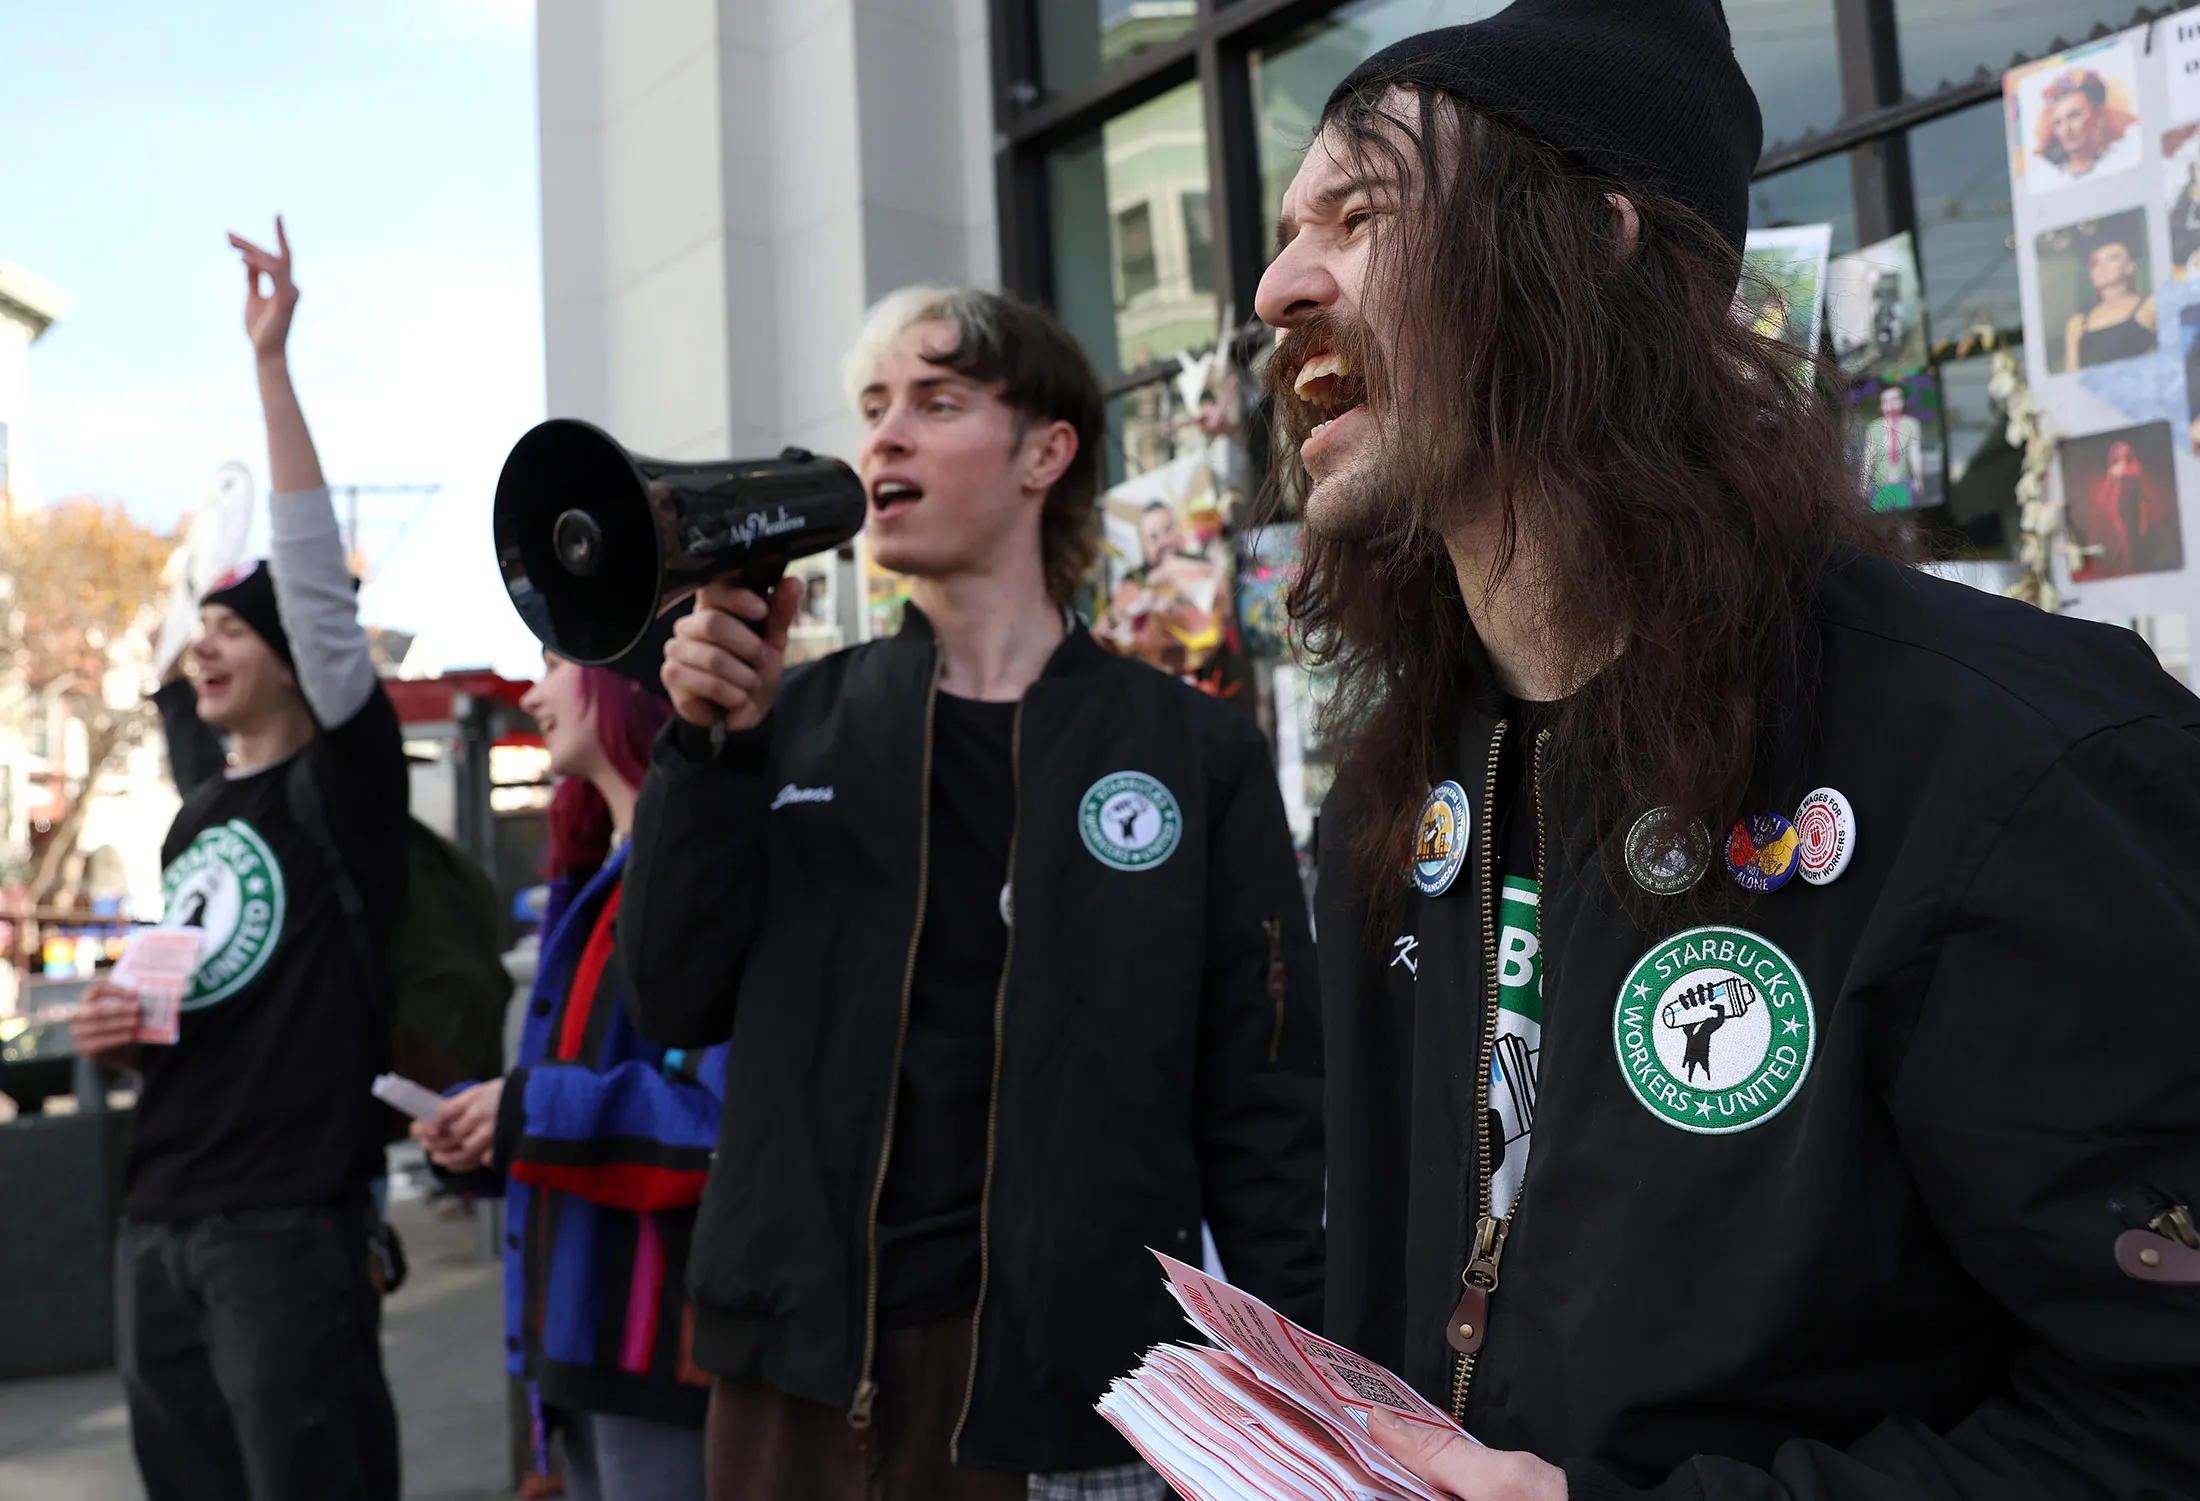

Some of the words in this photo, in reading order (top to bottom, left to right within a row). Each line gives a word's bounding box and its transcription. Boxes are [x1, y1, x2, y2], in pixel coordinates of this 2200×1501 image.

[1455, 803, 1465, 841] UNITED
[1793, 809, 1803, 828] ING
[1803, 793, 1829, 809] WAGES
[1828, 798, 1842, 819] FOR
[1799, 863, 1821, 881] UNDRY
[1821, 829, 1846, 878] WORKERS
[1420, 864, 1454, 894] FRANCISCO
[1735, 871, 1769, 891] ALONE
[1654, 938, 1796, 1009] STARBUCKS
[1623, 1005, 1693, 1113] WORKERS
[1717, 1045, 1799, 1117] UNITED
